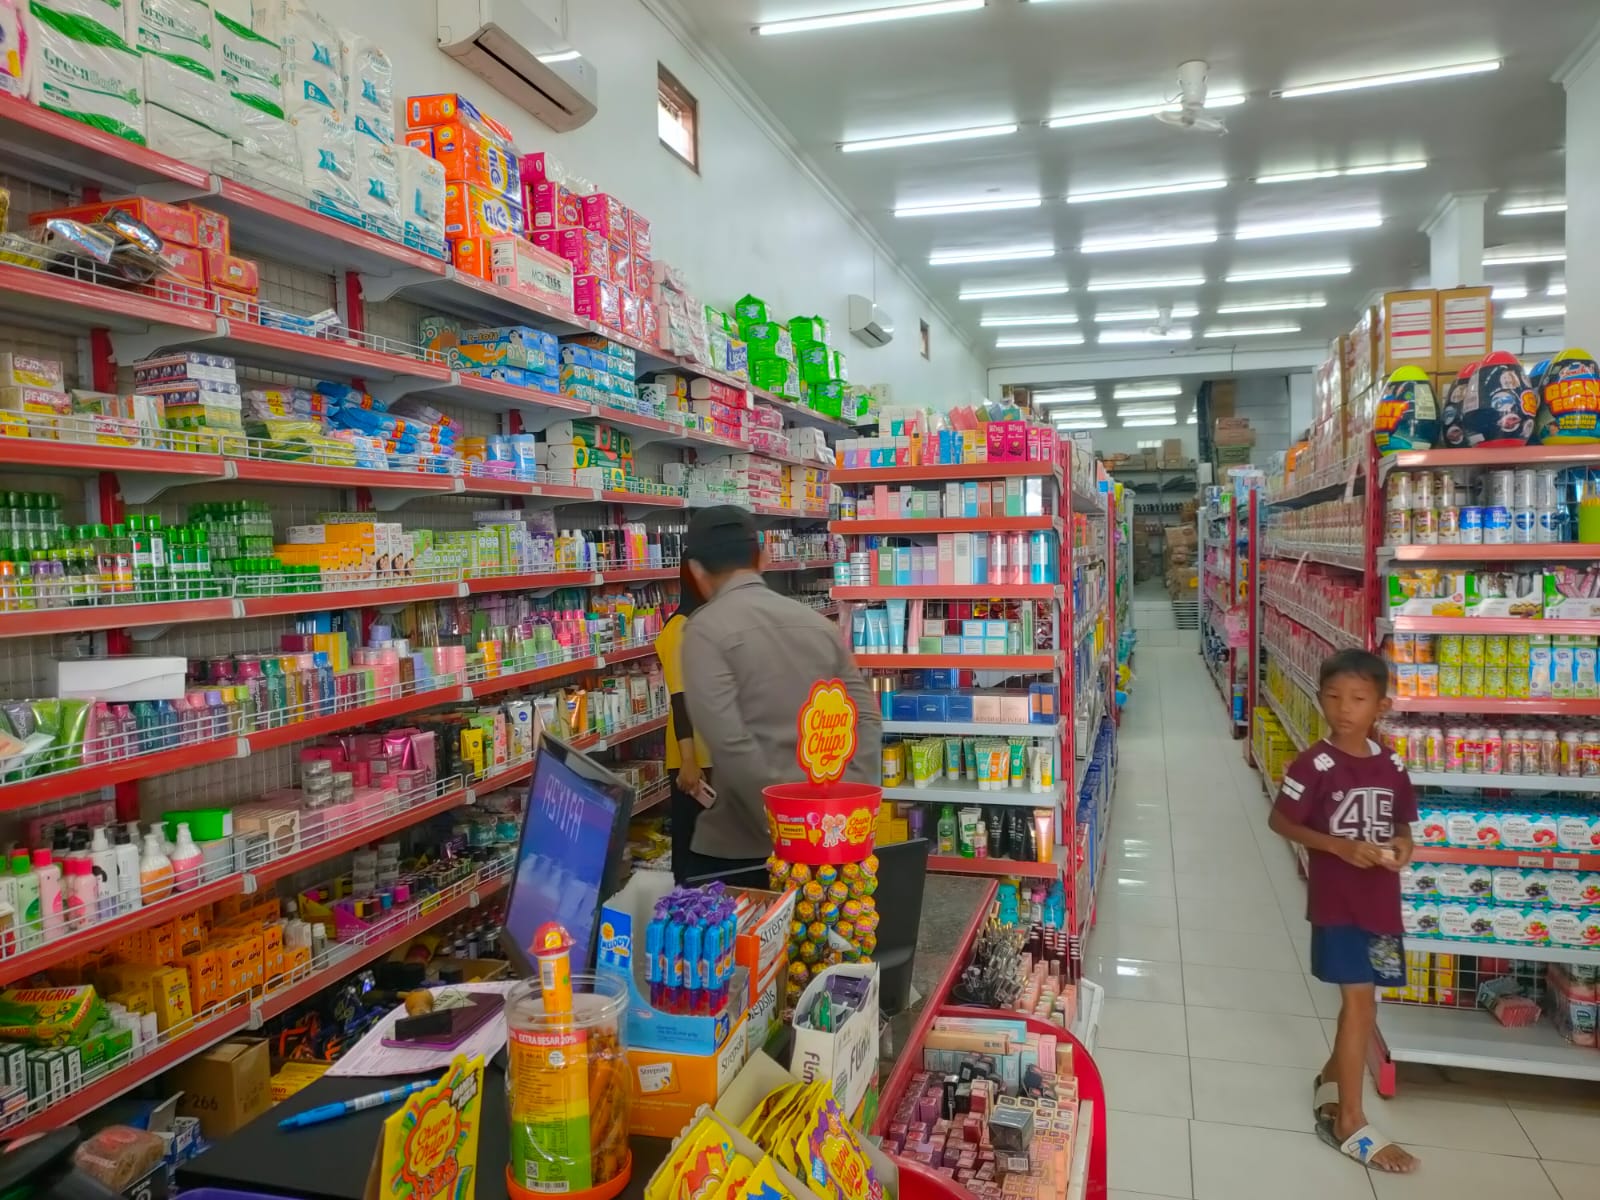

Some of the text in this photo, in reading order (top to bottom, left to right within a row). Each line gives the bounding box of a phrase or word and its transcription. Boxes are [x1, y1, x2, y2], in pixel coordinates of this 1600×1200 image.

[1545, 380, 1600, 402] GIAN
[810, 710, 848, 734] Chupa
[808, 732, 846, 756] Chups
[267, 940, 280, 950] GPU
[201, 965, 214, 976] GPU
[231, 958, 245, 968] GPU
[15, 988, 77, 1001] MIXAGRIP
[518, 1033, 537, 1043] EXTRA
[538, 1035, 560, 1046] BESAR
[192, 1094, 219, 1111] 266
[417, 1113, 452, 1147] Chupa
